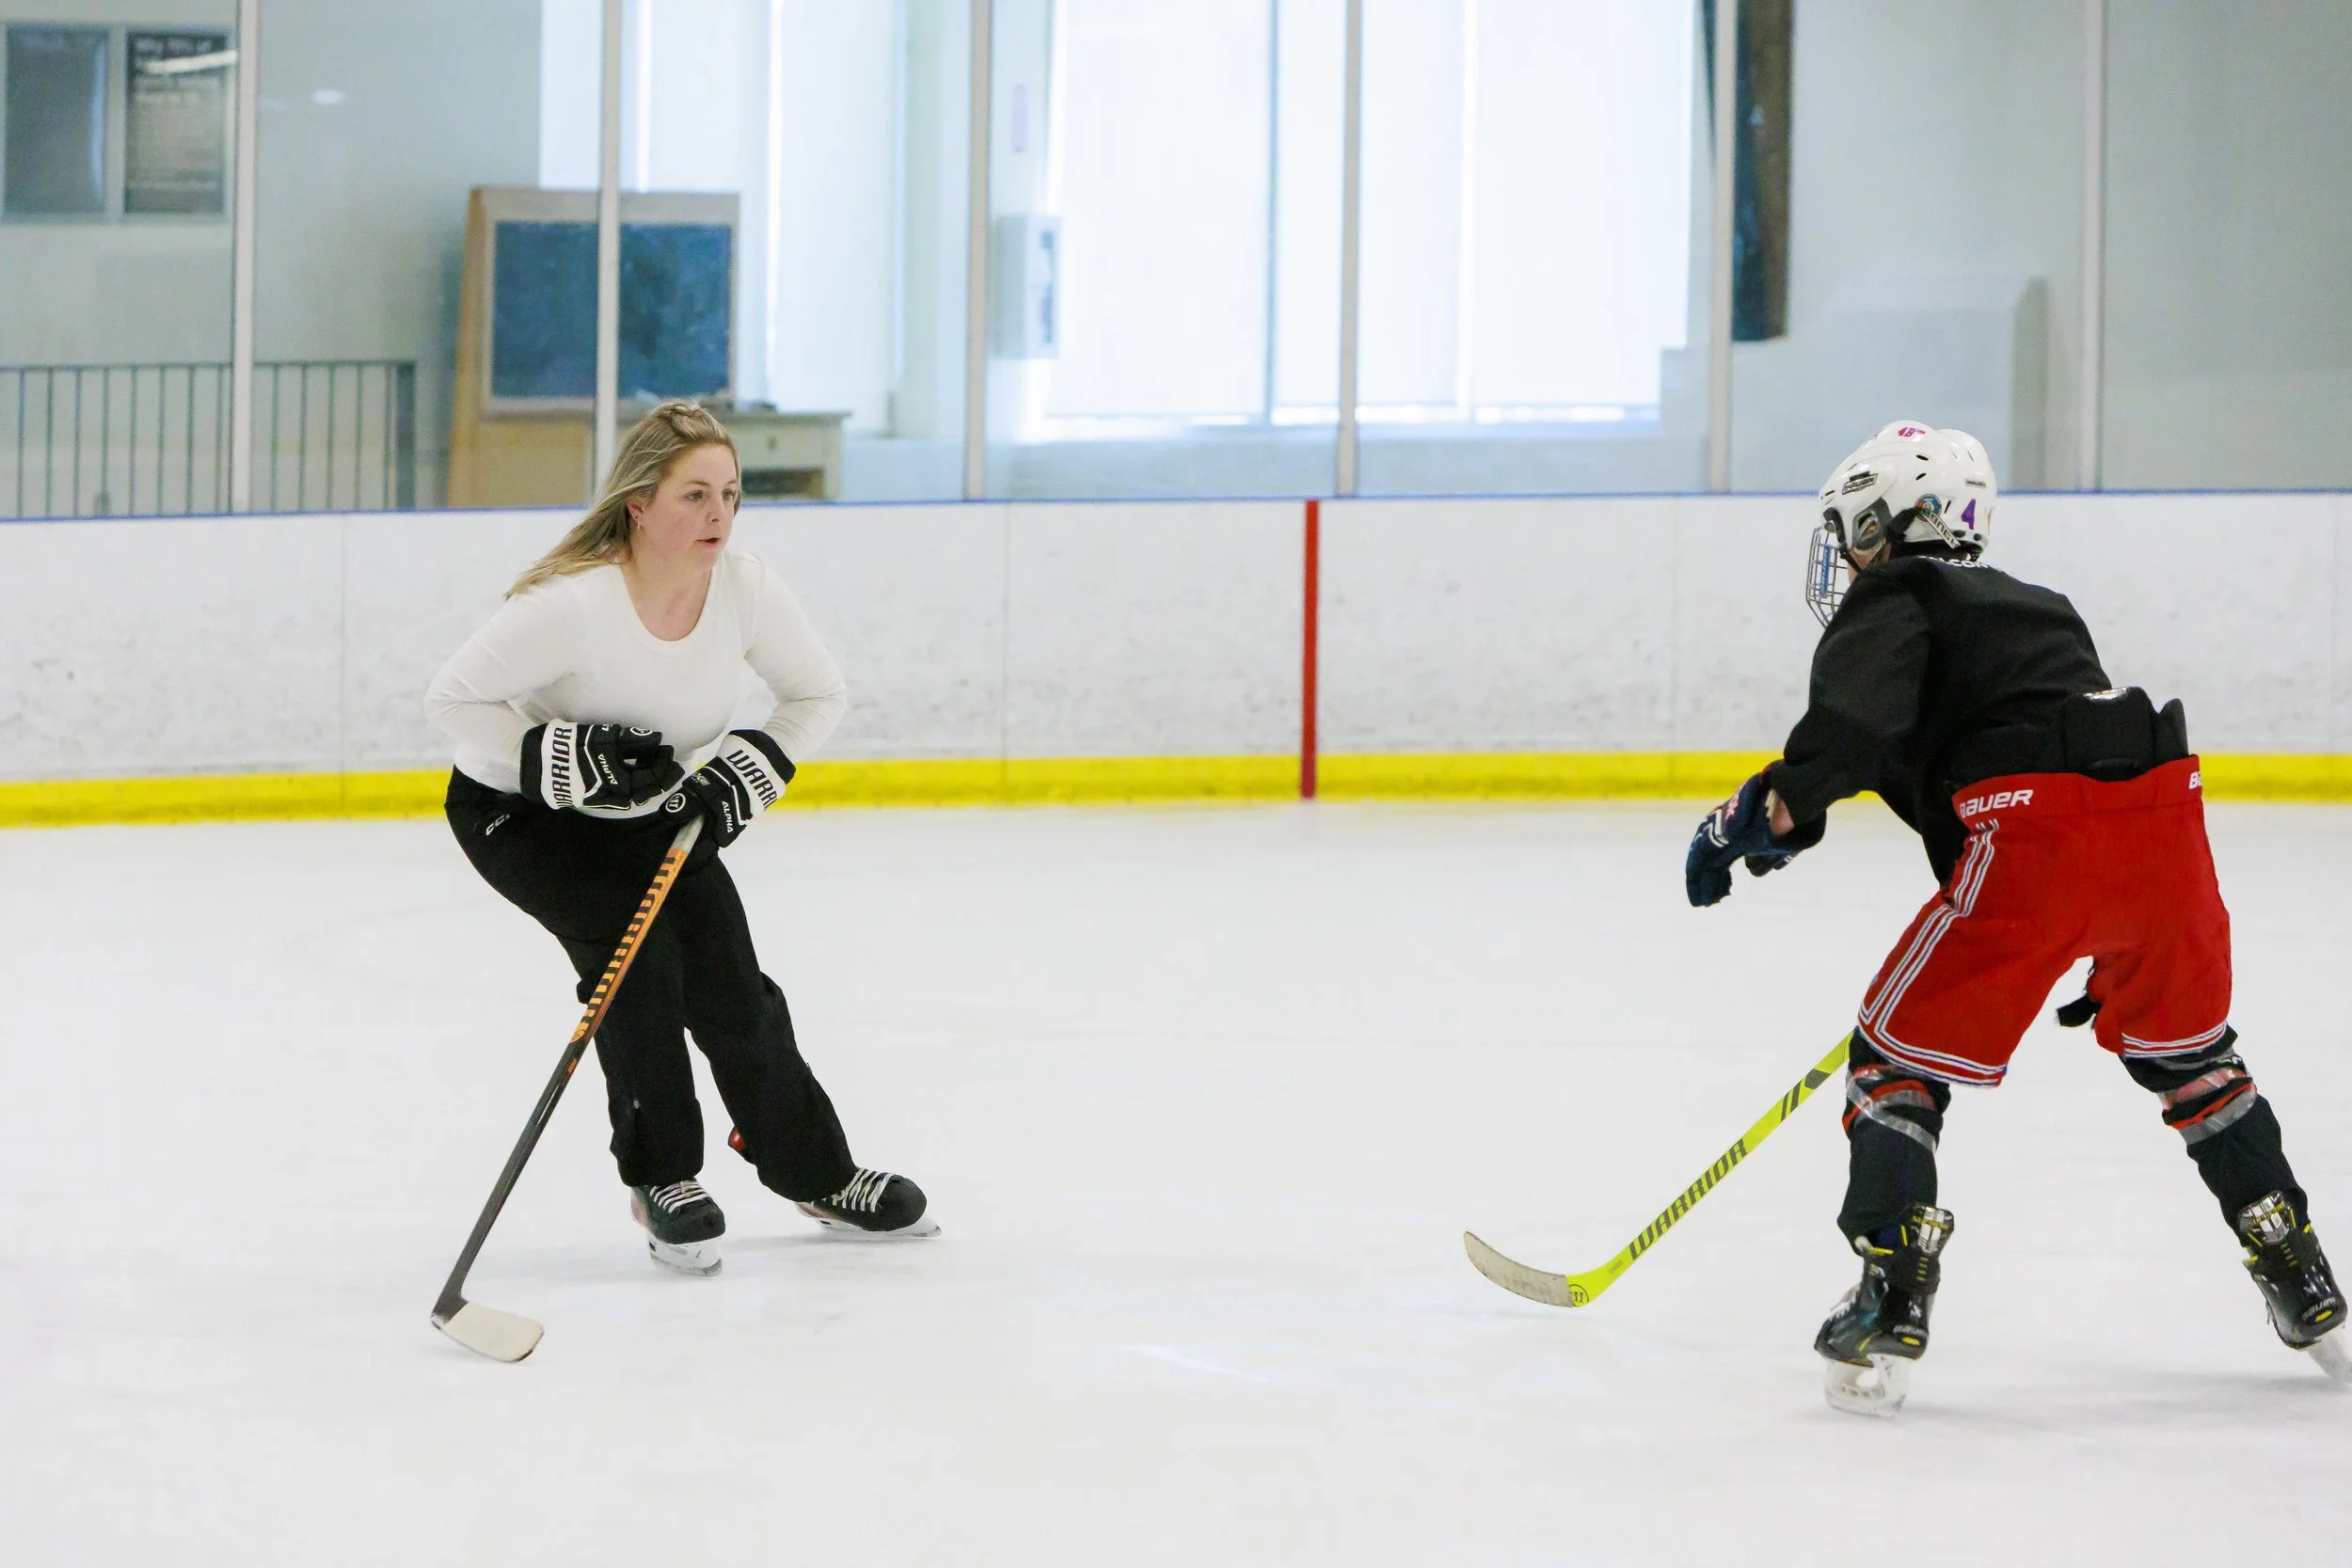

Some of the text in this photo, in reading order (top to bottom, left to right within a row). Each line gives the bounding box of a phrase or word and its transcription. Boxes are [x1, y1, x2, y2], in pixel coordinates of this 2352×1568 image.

[1961, 499, 1976, 531] 4
[598, 753, 618, 784] ALPHA
[726, 749, 778, 812] WARR
[722, 801, 734, 833] ALPHA
[1629, 1138, 1748, 1260] WARRIOR
